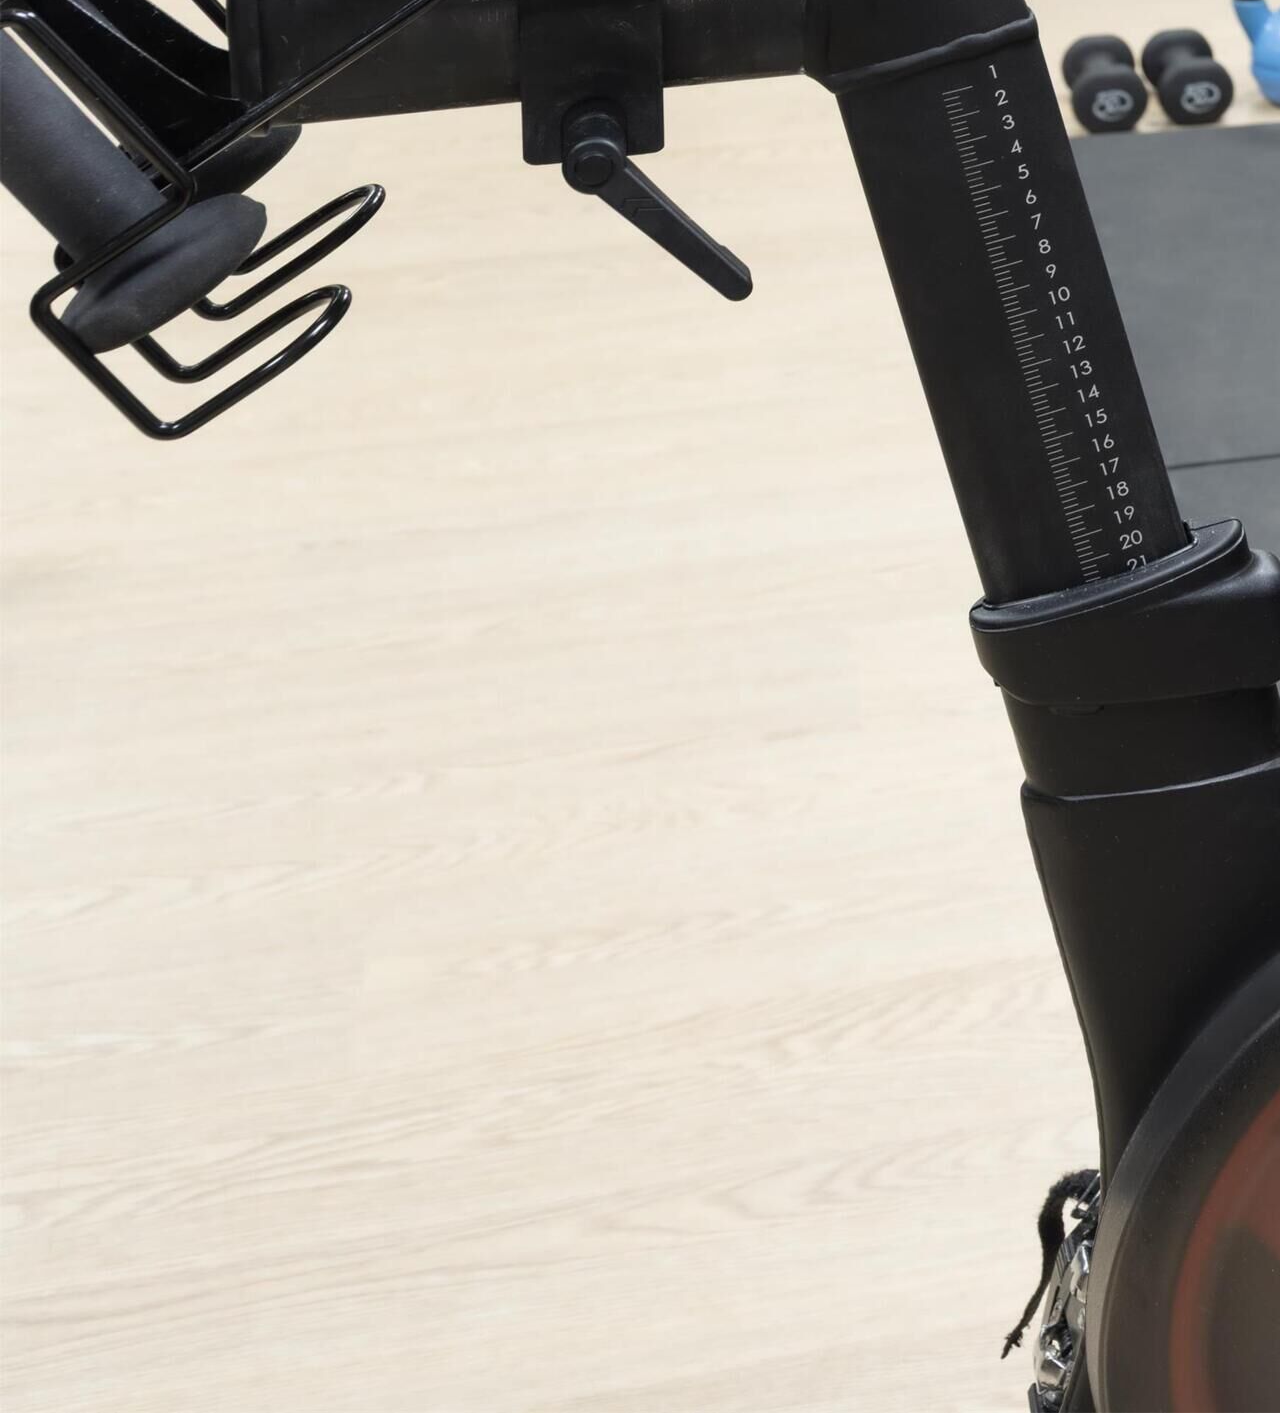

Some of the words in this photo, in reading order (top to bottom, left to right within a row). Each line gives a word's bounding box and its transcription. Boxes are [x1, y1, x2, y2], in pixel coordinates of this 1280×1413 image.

[989, 65, 997, 78] 1
[995, 90, 1008, 106] 2
[1002, 115, 1015, 130] 3
[1011, 139, 1022, 153] 4
[1018, 164, 1029, 179] 5
[1026, 189, 1036, 204] 6
[1031, 213, 1041, 230] 7
[1038, 239, 1051, 254] 8
[1046, 264, 1056, 278] 9
[1048, 286, 1070, 305] 10
[1056, 312, 1074, 329] 11
[1063, 335, 1086, 354] 12
[1070, 360, 1092, 378] 13
[1077, 384, 1099, 403] 14
[1085, 408, 1107, 427] 15
[1092, 434, 1114, 452] 16
[1100, 457, 1119, 475] 17
[1107, 481, 1129, 500] 18
[1114, 506, 1134, 524] 19
[1120, 530, 1142, 550] 20
[1127, 555, 1147, 571] 21
